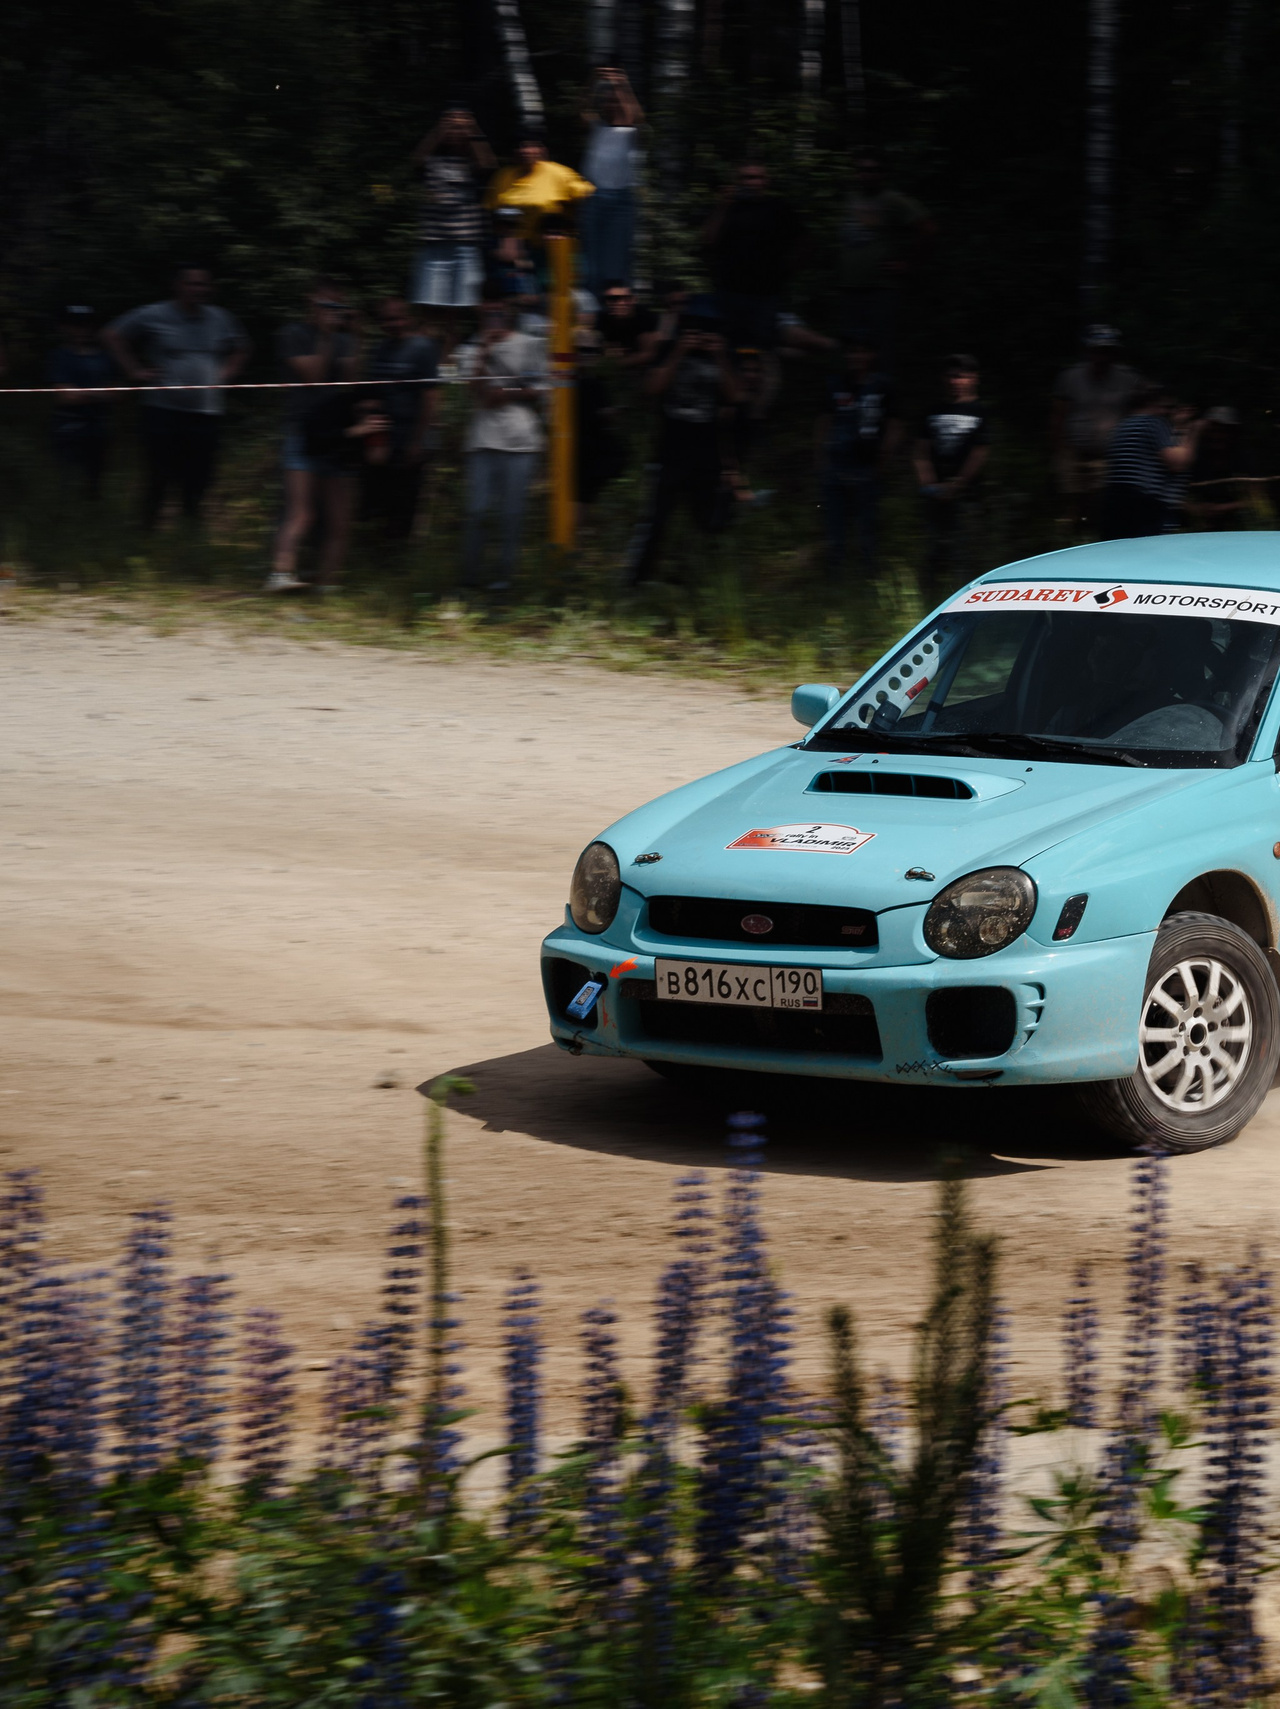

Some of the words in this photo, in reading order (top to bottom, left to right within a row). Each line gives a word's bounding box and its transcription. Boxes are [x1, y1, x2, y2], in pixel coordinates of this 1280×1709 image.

[965, 588, 1093, 604] SUDAREV
[806, 825, 822, 834] 2
[770, 837, 857, 847] VLADIMIR
[774, 969, 818, 995] 190
[780, 997, 800, 1008] RUS
